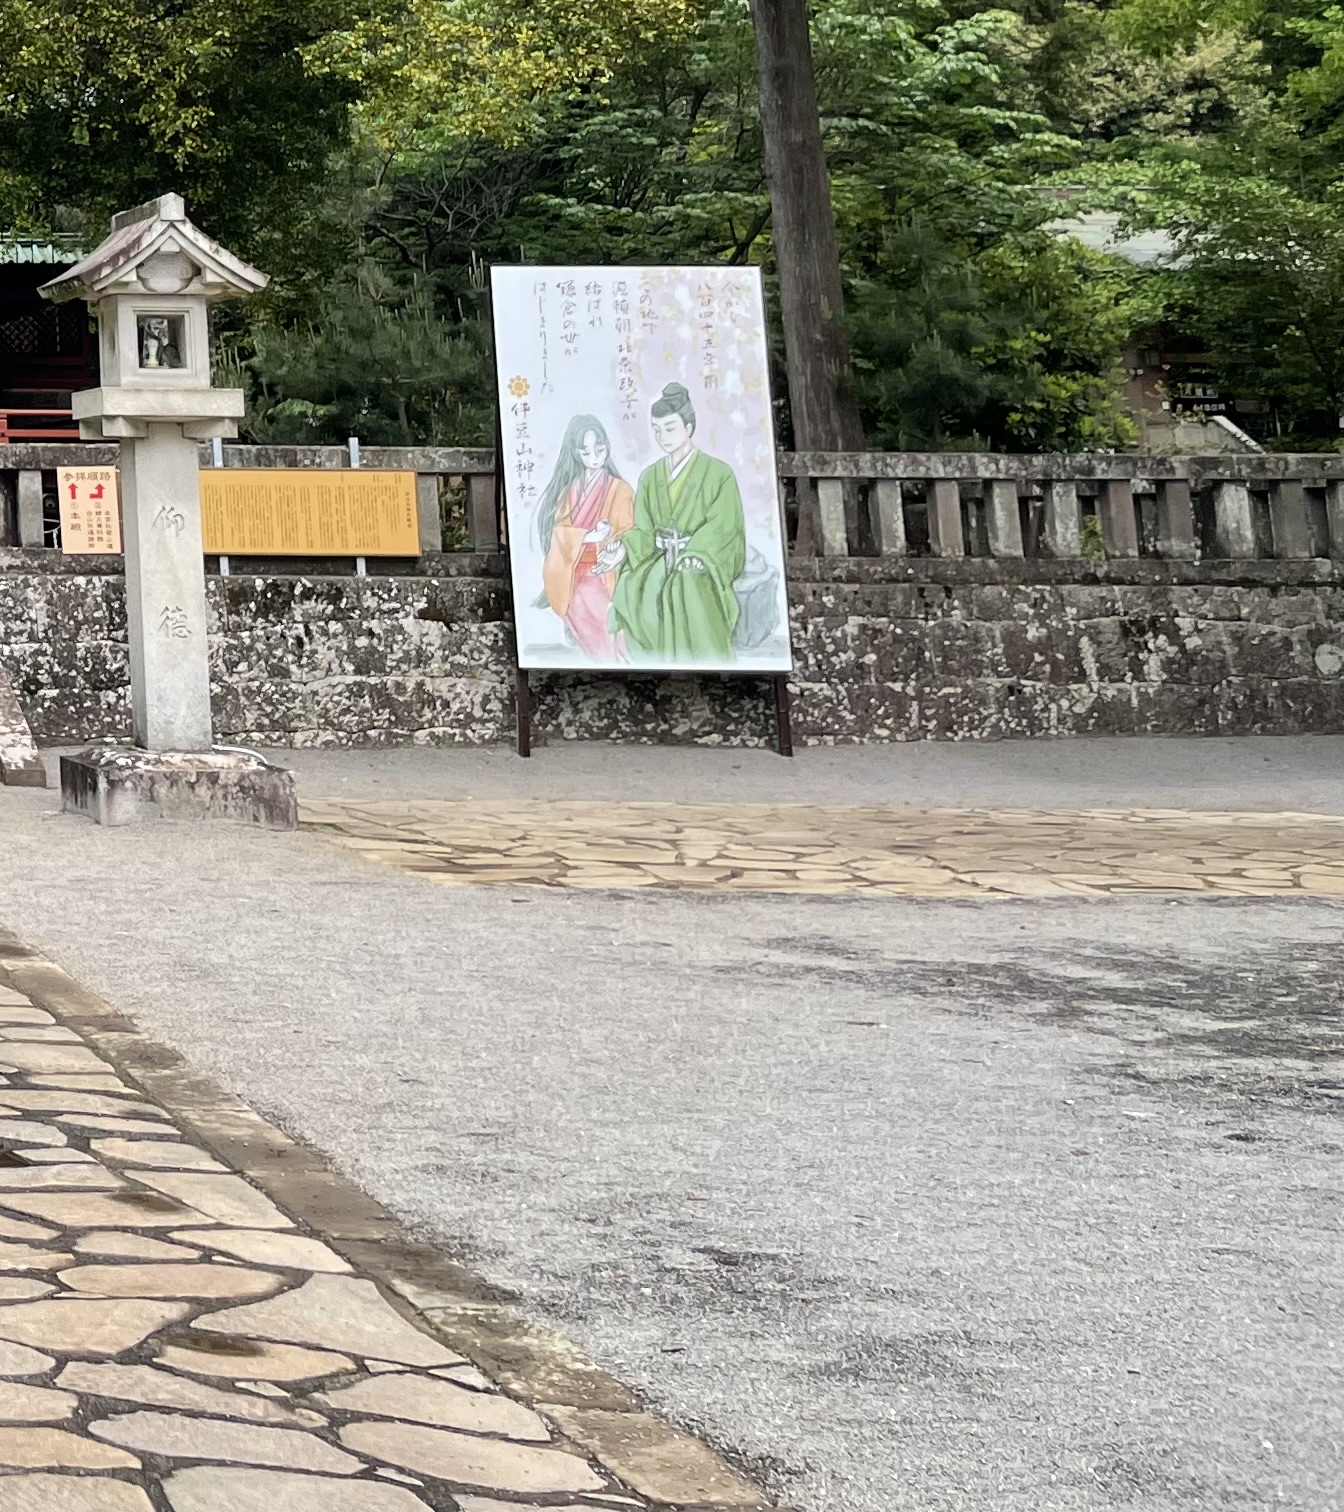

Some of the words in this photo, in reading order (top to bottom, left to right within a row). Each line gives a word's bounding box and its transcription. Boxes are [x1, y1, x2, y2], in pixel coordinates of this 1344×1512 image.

[533, 279, 554, 394] はじまりました
[556, 279, 581, 356] 鎌倉の世が
[584, 280, 603, 327] 結ばれ
[696, 282, 719, 390] 八百四十五年前
[721, 281, 741, 324] 今から
[64, 471, 111, 482] 参拝順路
[511, 402, 538, 498] 伊豆山神社
